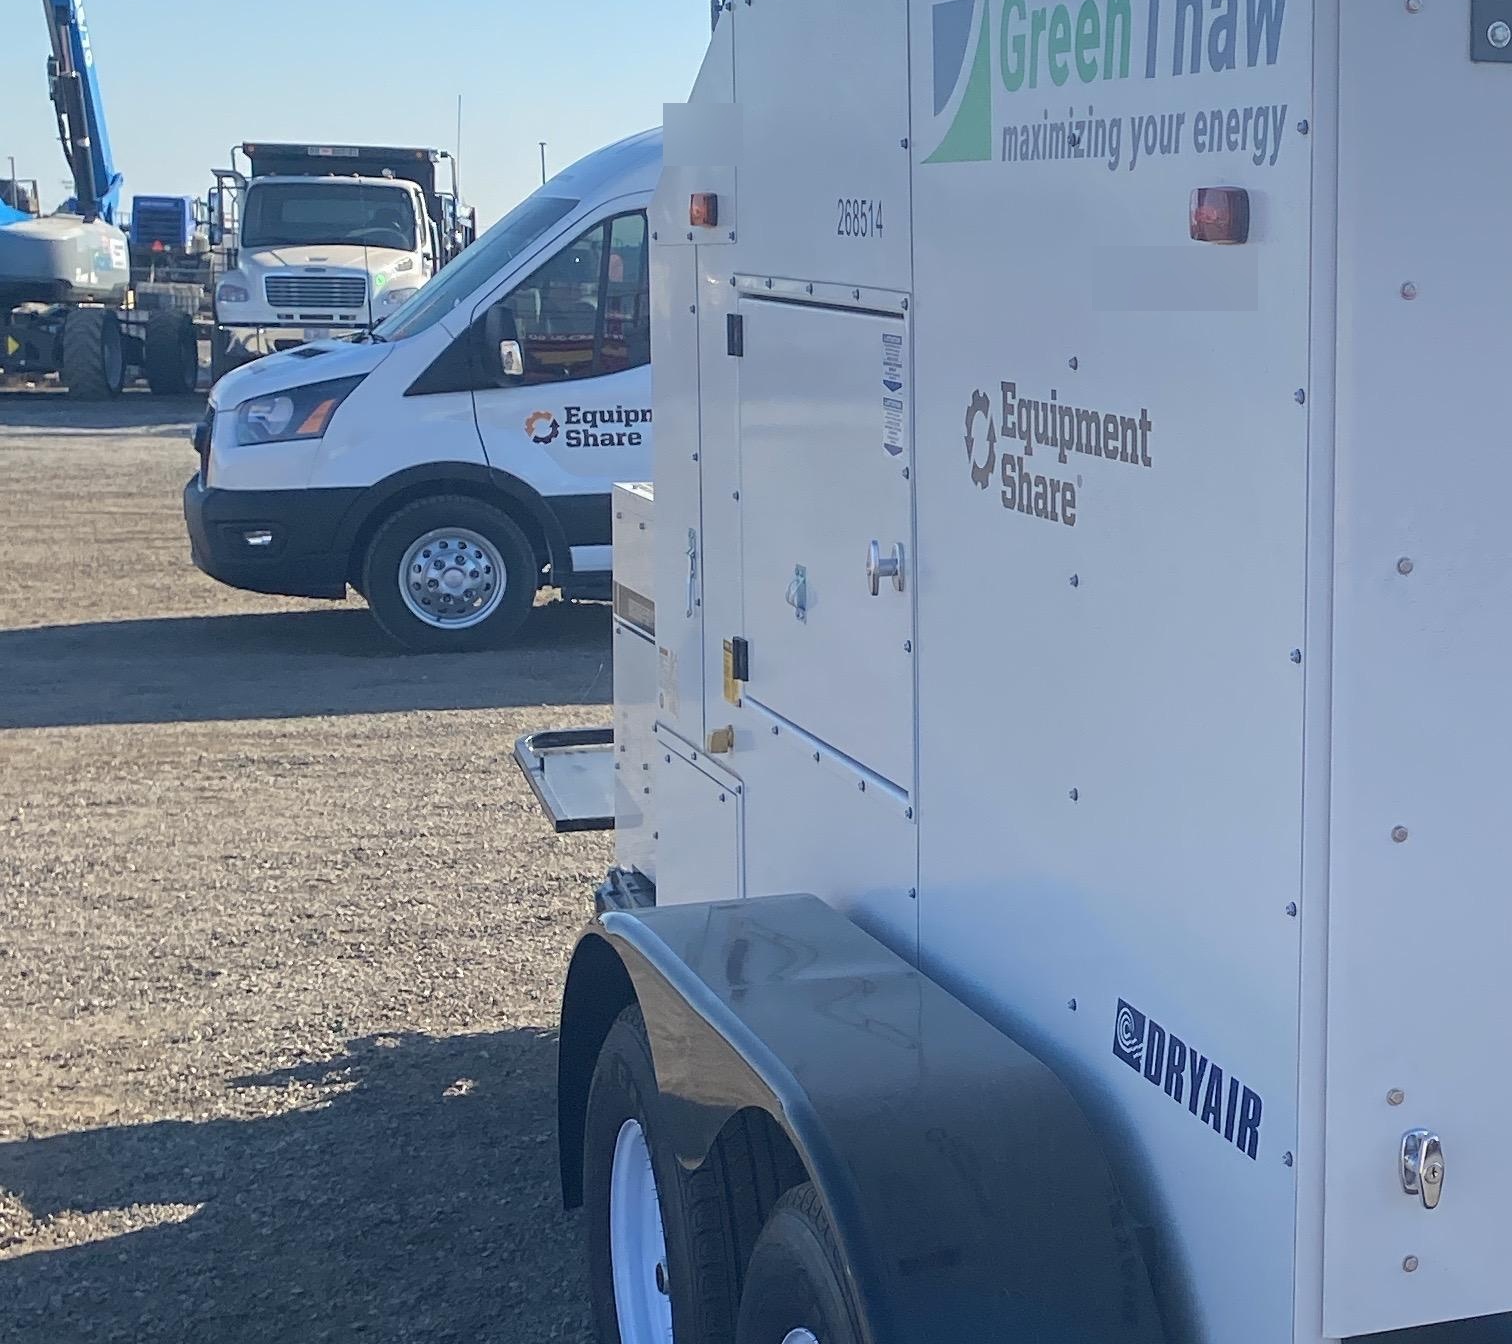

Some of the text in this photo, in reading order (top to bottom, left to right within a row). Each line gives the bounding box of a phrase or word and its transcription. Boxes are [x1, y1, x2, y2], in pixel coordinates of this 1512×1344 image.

[1001, 104, 1288, 171] maximizing your energy
[837, 198, 884, 238] 268514
[566, 429, 642, 448] Share
[1001, 381, 1152, 468] Equipment
[1002, 453, 1076, 527] Share
[1143, 1018, 1263, 1161] DRYAIR
